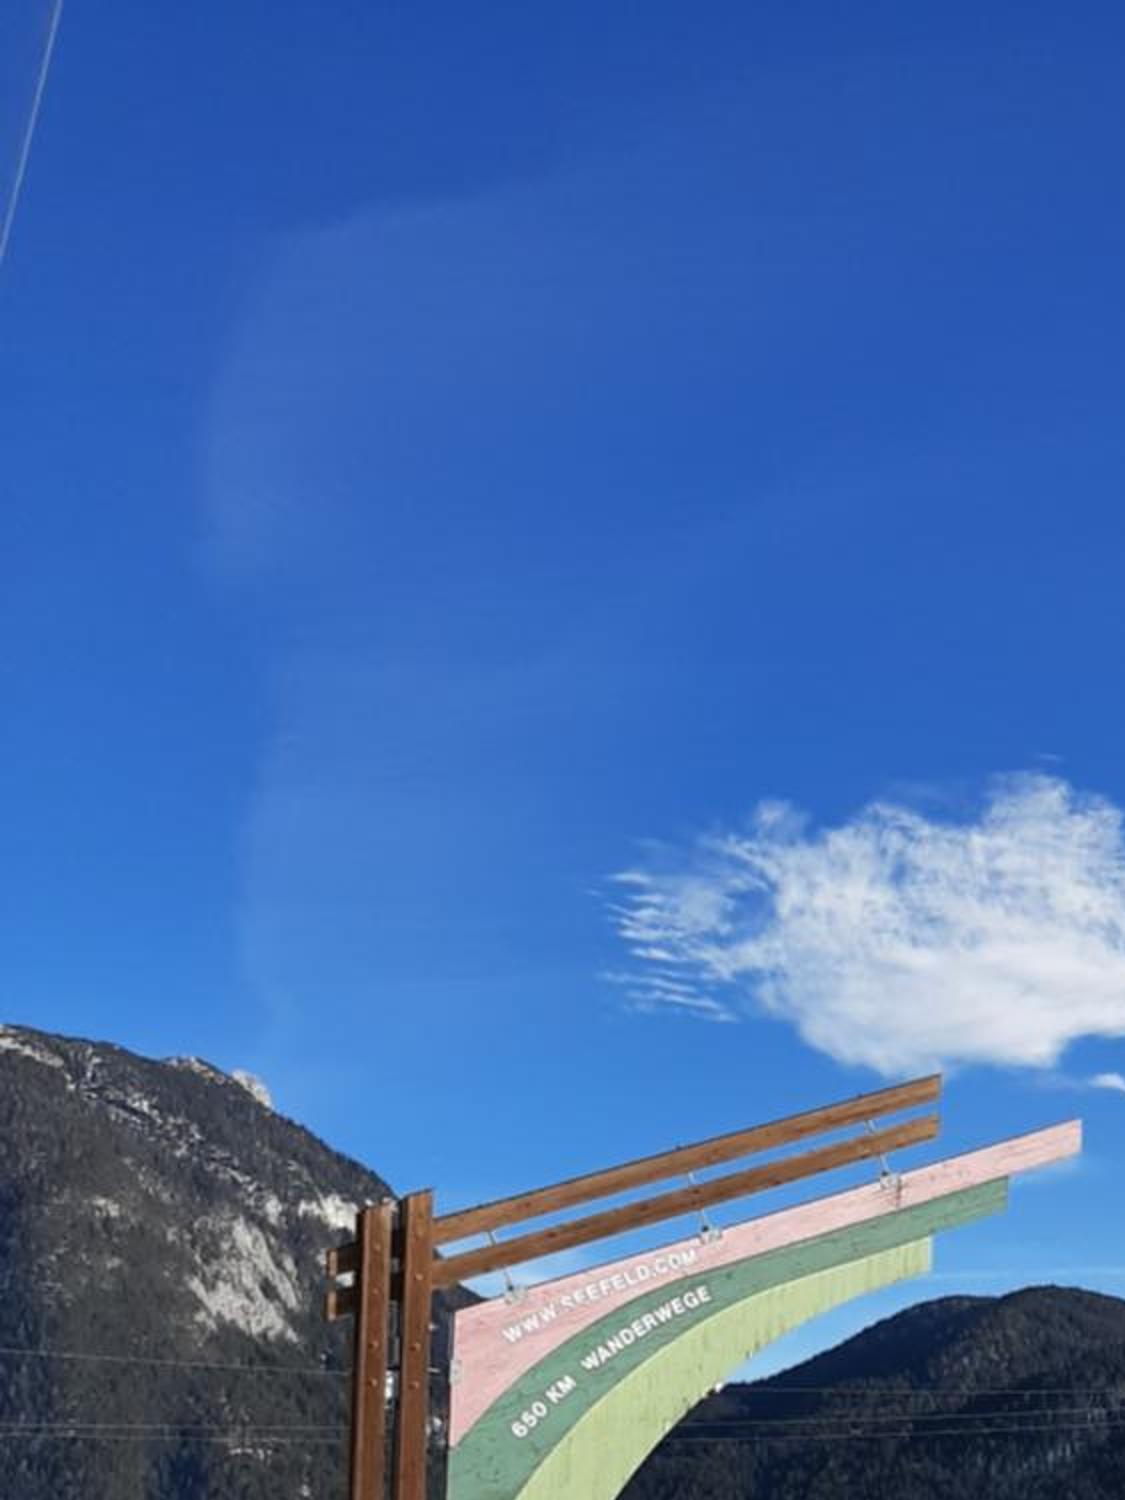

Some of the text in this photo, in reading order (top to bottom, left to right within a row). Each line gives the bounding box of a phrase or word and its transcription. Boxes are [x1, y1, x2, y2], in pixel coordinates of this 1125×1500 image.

[511, 1286, 712, 1439] 650 KM WANDERWEGE
